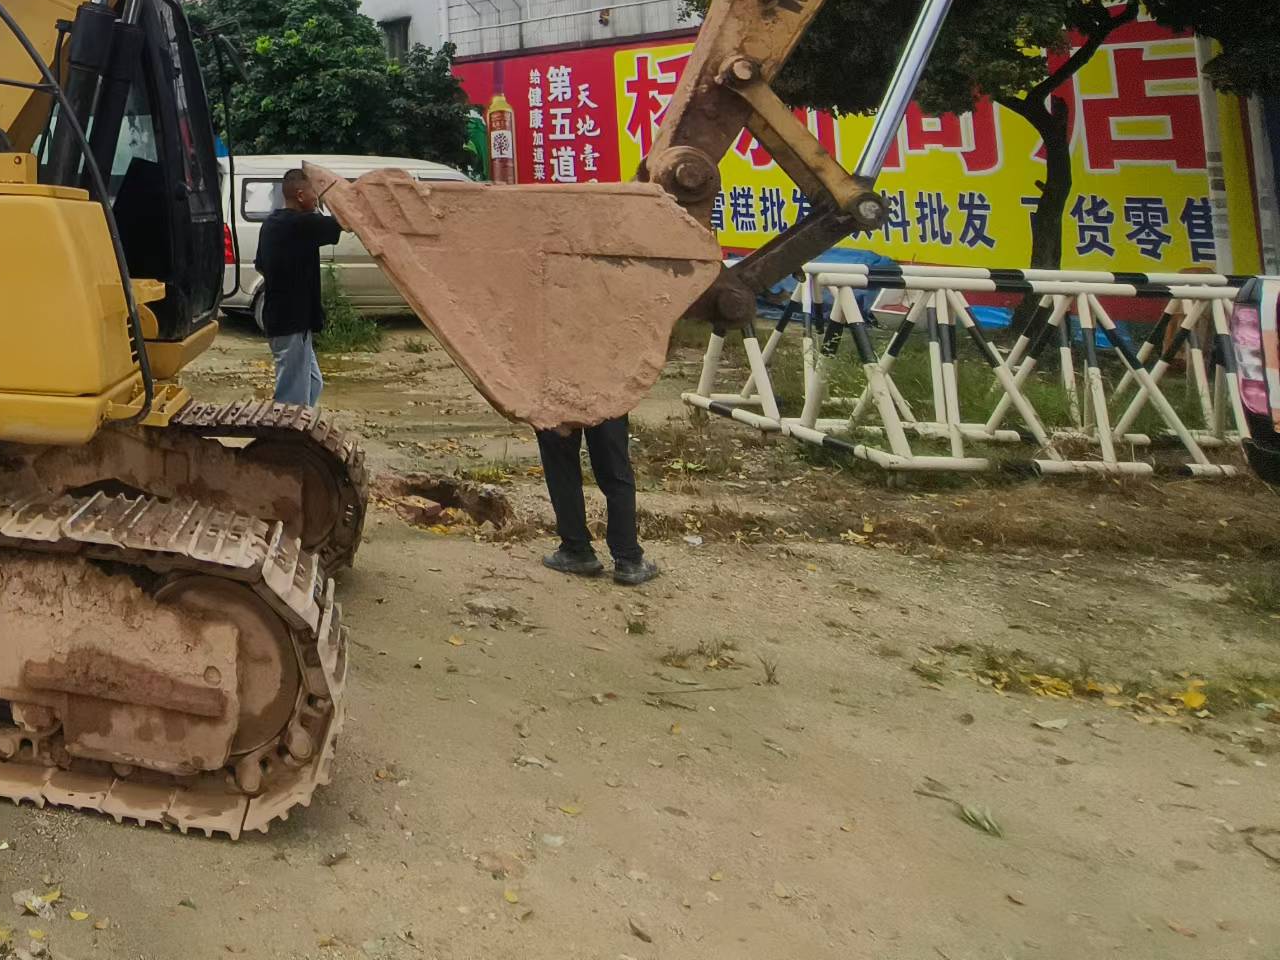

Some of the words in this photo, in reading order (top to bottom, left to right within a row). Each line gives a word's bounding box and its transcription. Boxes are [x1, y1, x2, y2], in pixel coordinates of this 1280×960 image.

[528, 67, 546, 180] 给健康加道菜
[546, 65, 578, 183] 第五道
[576, 84, 601, 183] 天地壹
[852, 190, 996, 248] 料批发
